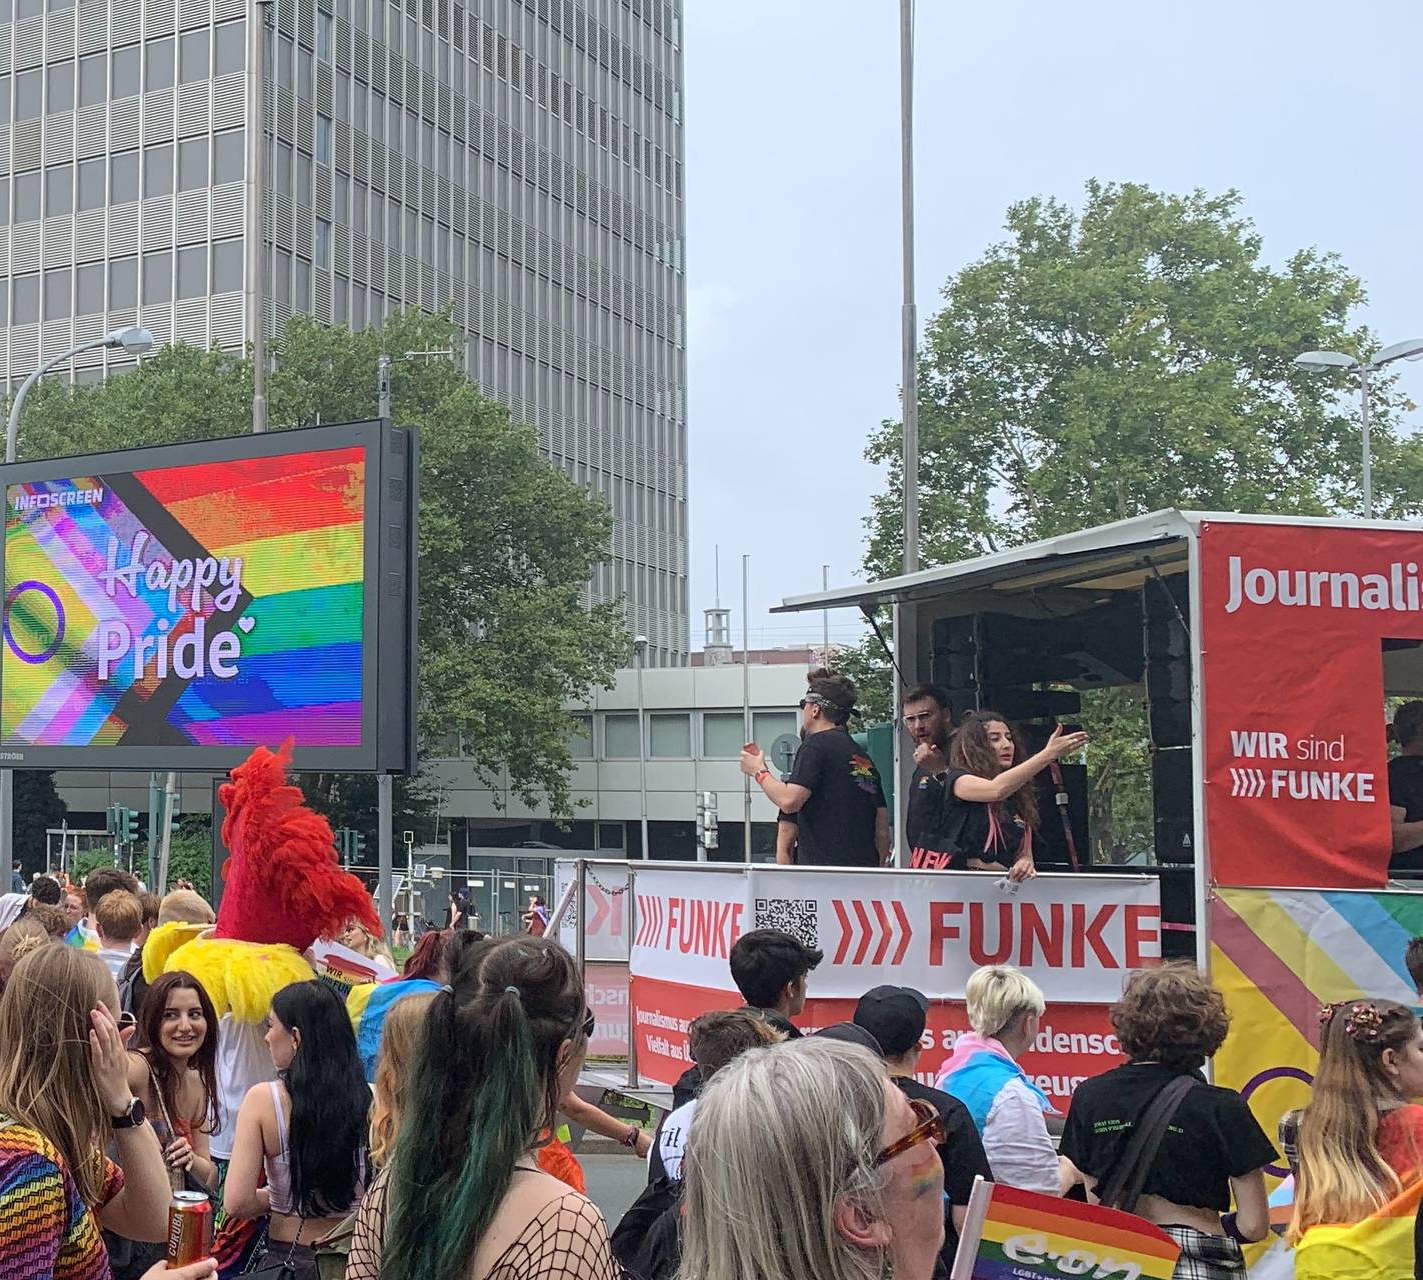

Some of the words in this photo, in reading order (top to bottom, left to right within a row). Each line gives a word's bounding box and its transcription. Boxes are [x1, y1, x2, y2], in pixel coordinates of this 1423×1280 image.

[97, 529, 243, 613] Happy
[1224, 555, 1423, 614] Journali
[97, 616, 241, 681] Pride
[1230, 730, 1289, 759] WIR
[1296, 734, 1345, 761] sind
[1271, 769, 1376, 802] FUNKE
[666, 897, 744, 960] FUNKE
[929, 901, 1162, 969] FUNKE
[326, 965, 343, 979] WIR
[168, 1213, 185, 1257] CURUBA
